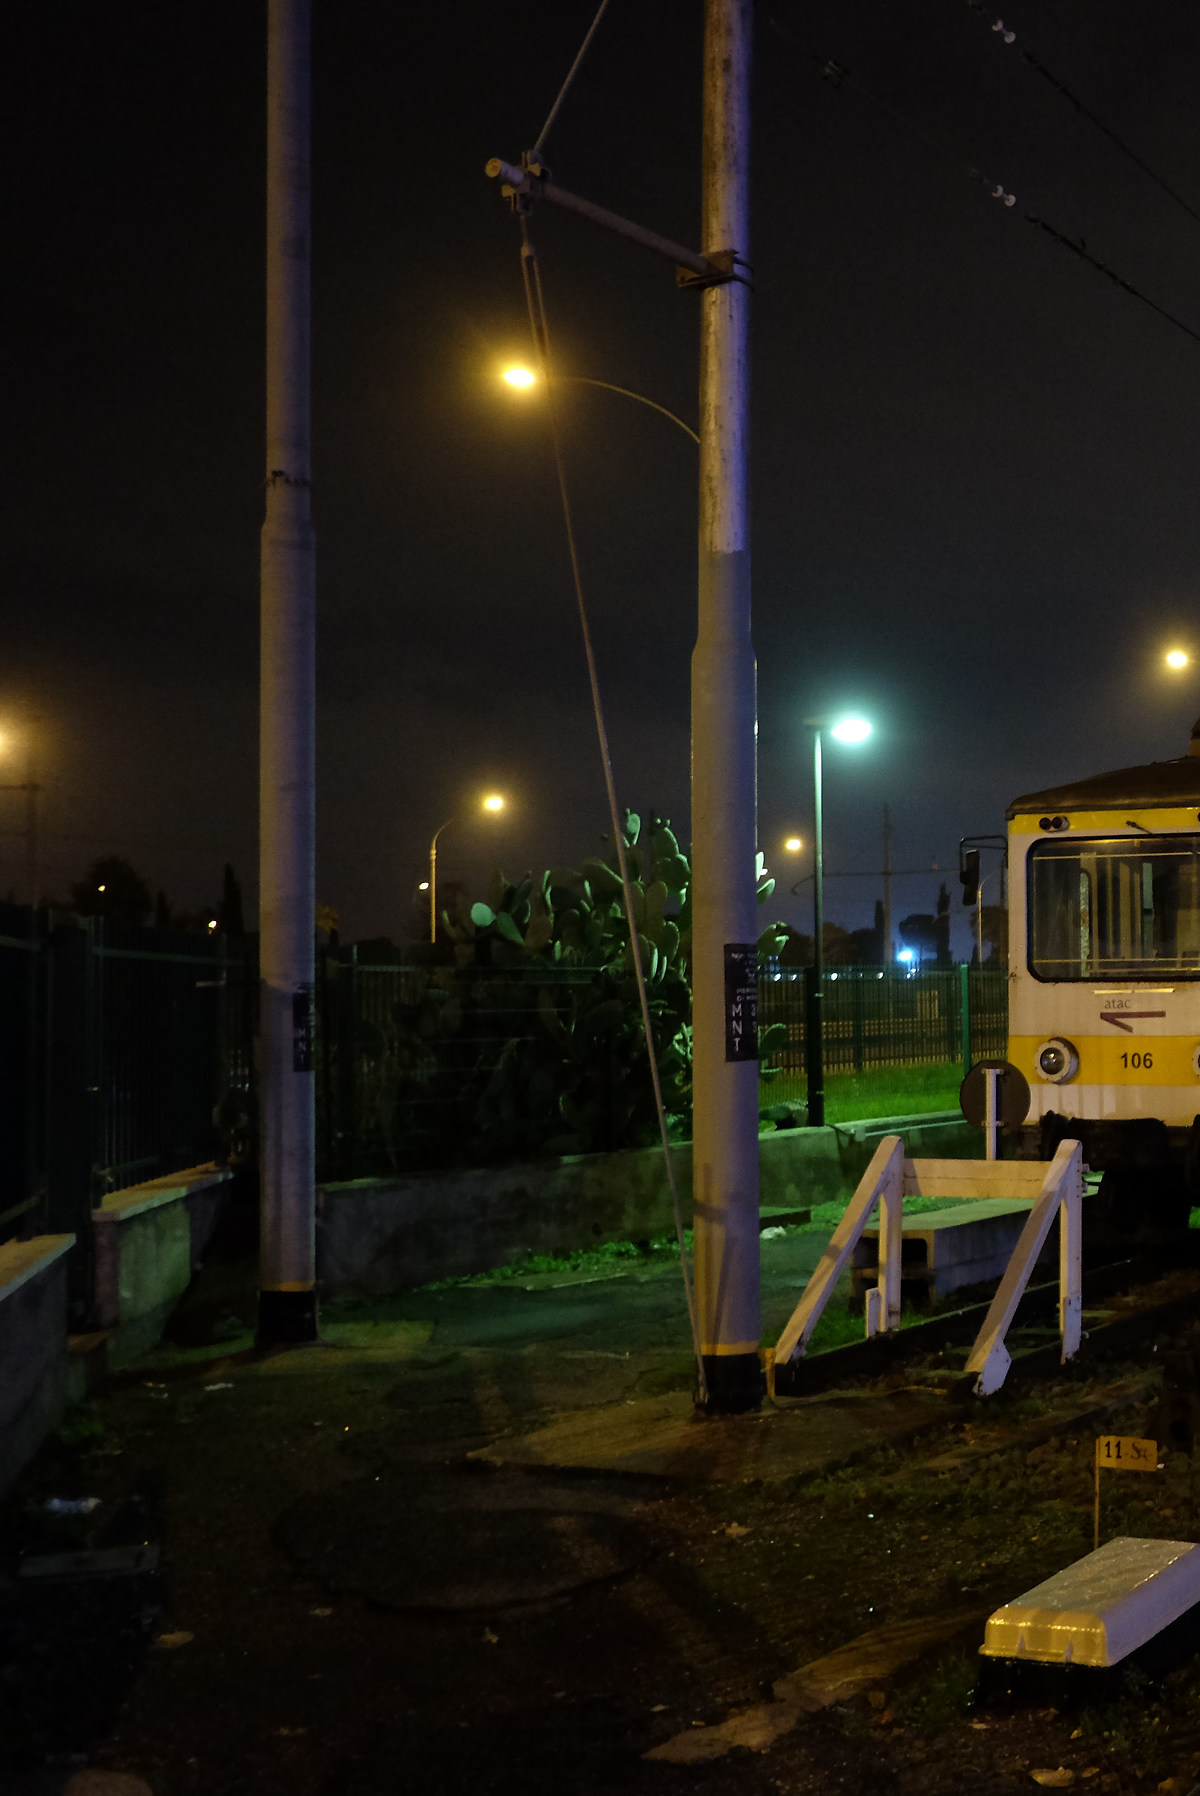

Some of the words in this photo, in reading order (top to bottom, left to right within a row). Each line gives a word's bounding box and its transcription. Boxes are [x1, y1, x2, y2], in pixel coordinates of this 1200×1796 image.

[1104, 998, 1132, 1010] atac
[1121, 1051, 1153, 1070] 106
[1104, 1440, 1122, 1459] 11
